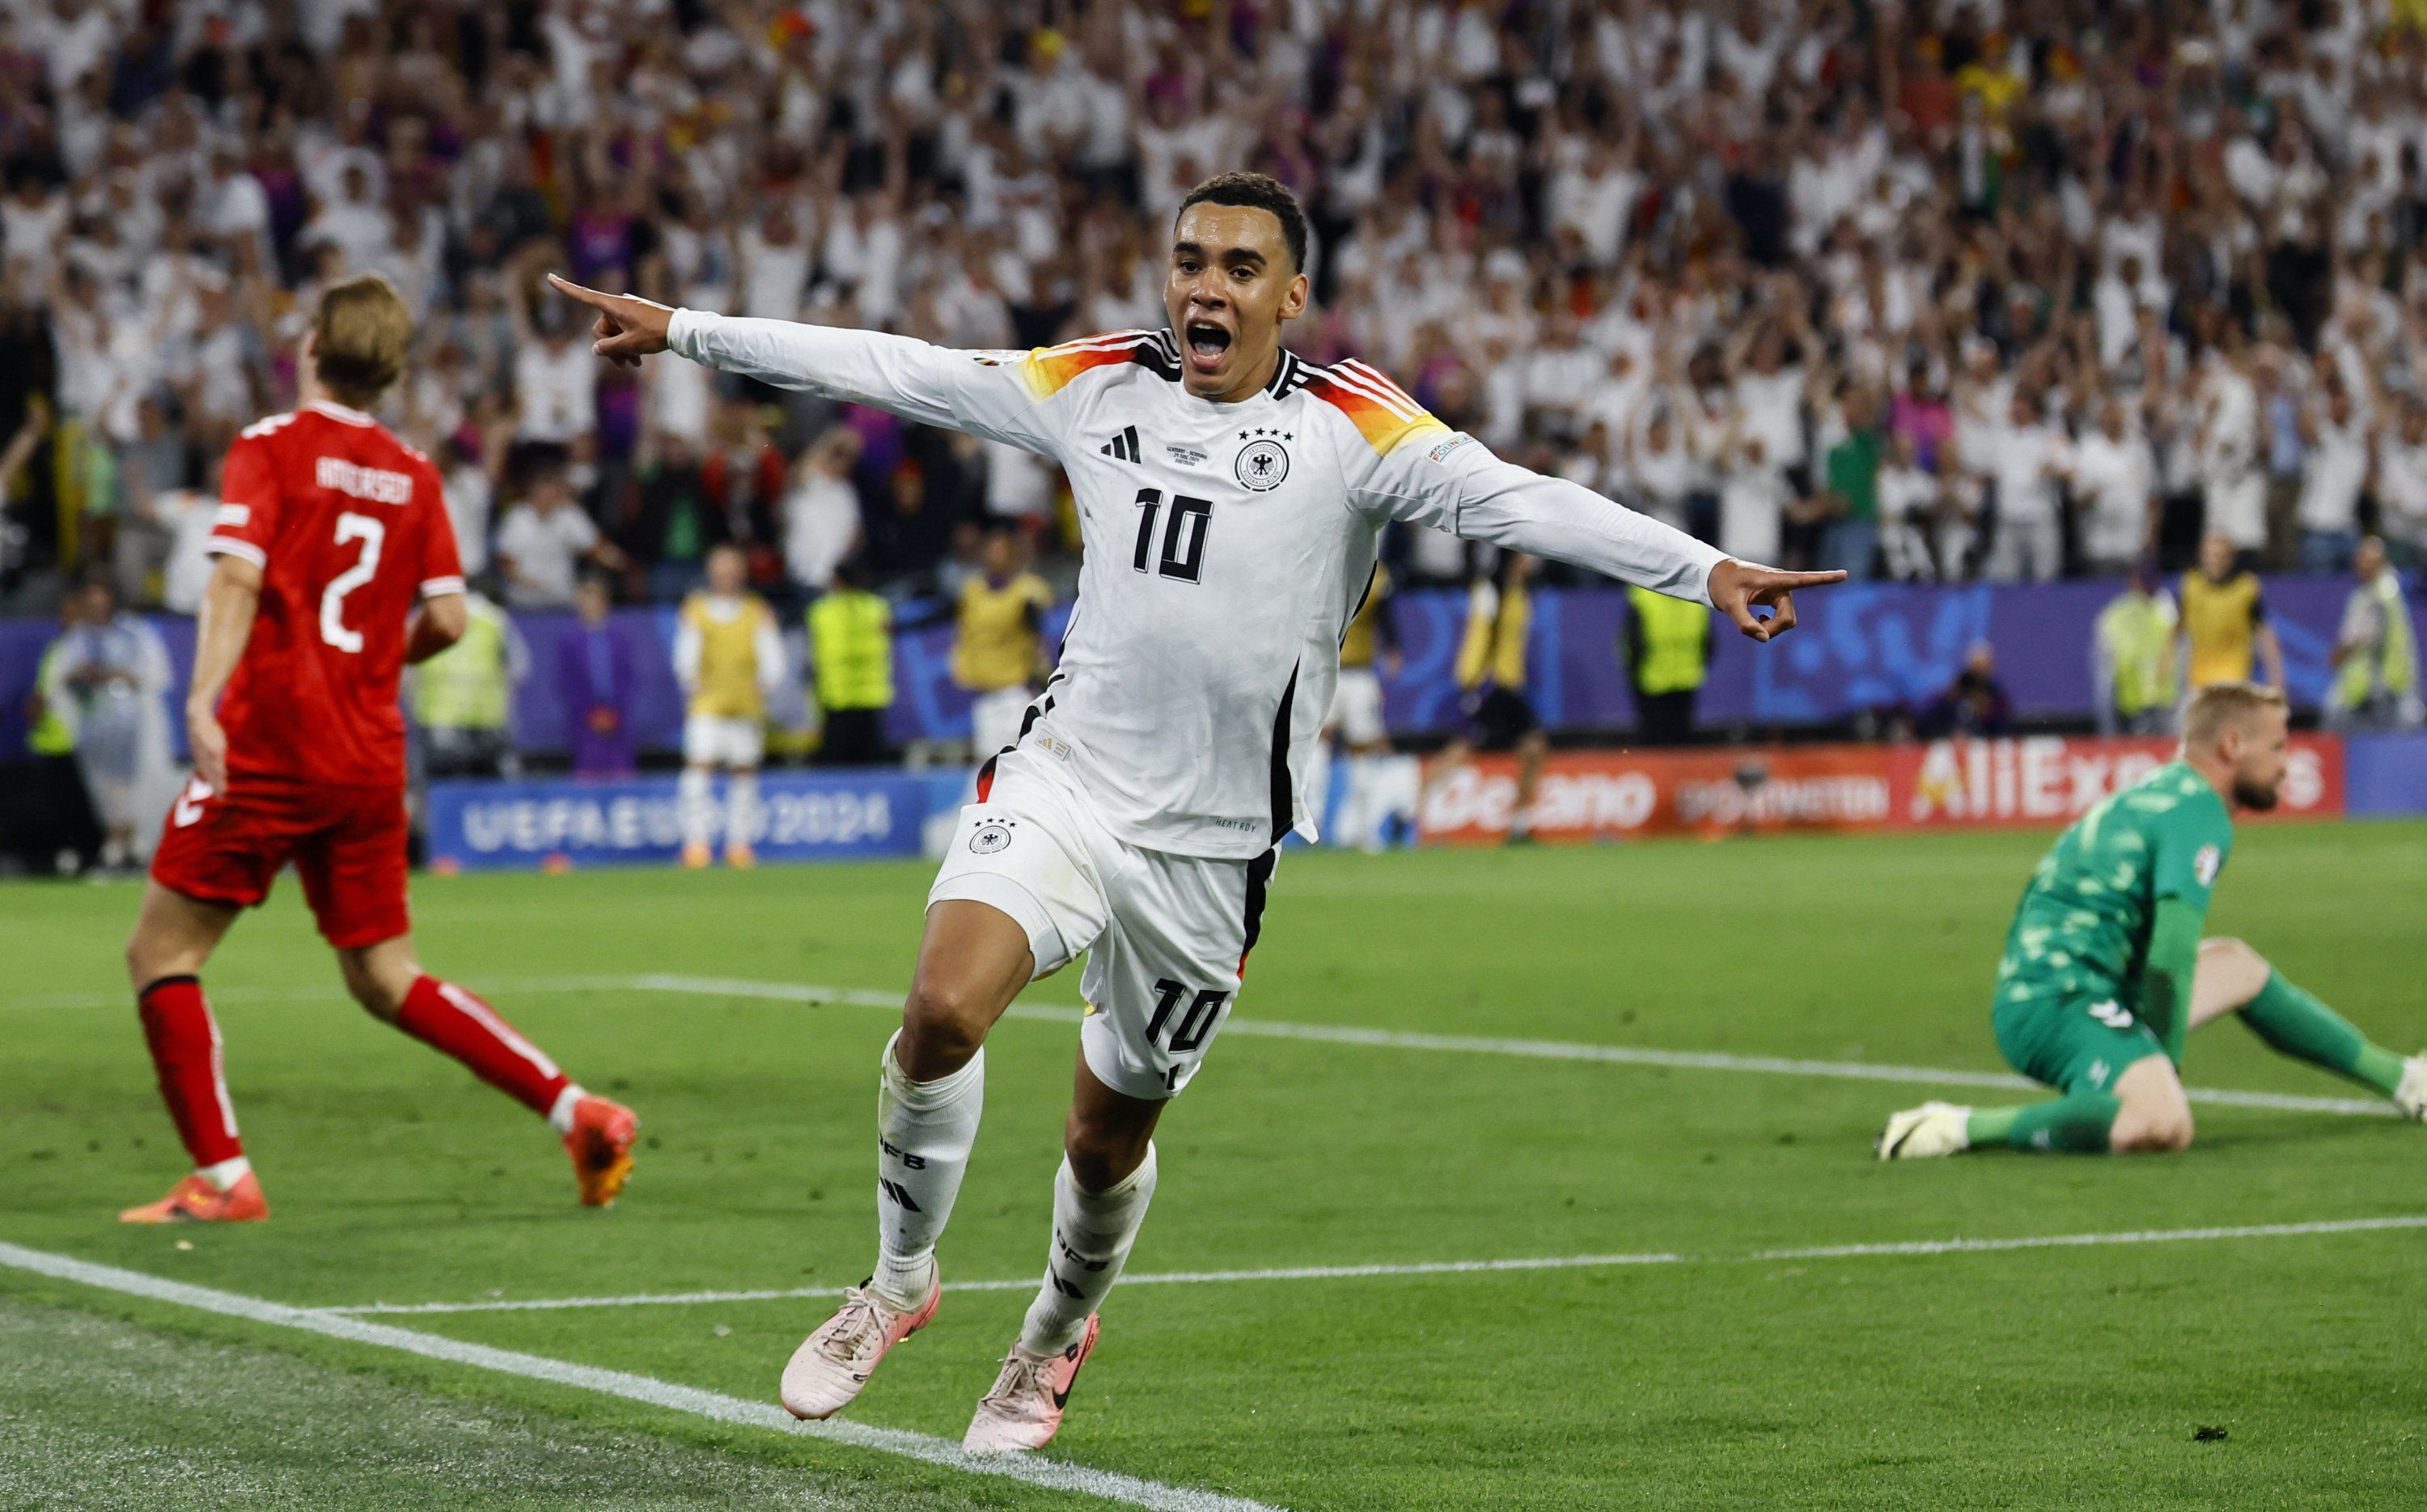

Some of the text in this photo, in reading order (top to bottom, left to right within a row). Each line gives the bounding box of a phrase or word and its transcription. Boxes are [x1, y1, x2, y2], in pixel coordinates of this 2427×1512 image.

[1247, 446, 1279, 455] DEUTSCHER
[1432, 434, 1473, 462] FOUNDA
[1133, 488, 1215, 585] 10
[319, 510, 386, 654] 2
[1422, 764, 1657, 832] Beano
[1910, 737, 2326, 820] AliExps
[462, 797, 608, 852] UEFA
[769, 792, 891, 845] 2024
[1146, 978, 1230, 1054] 10
